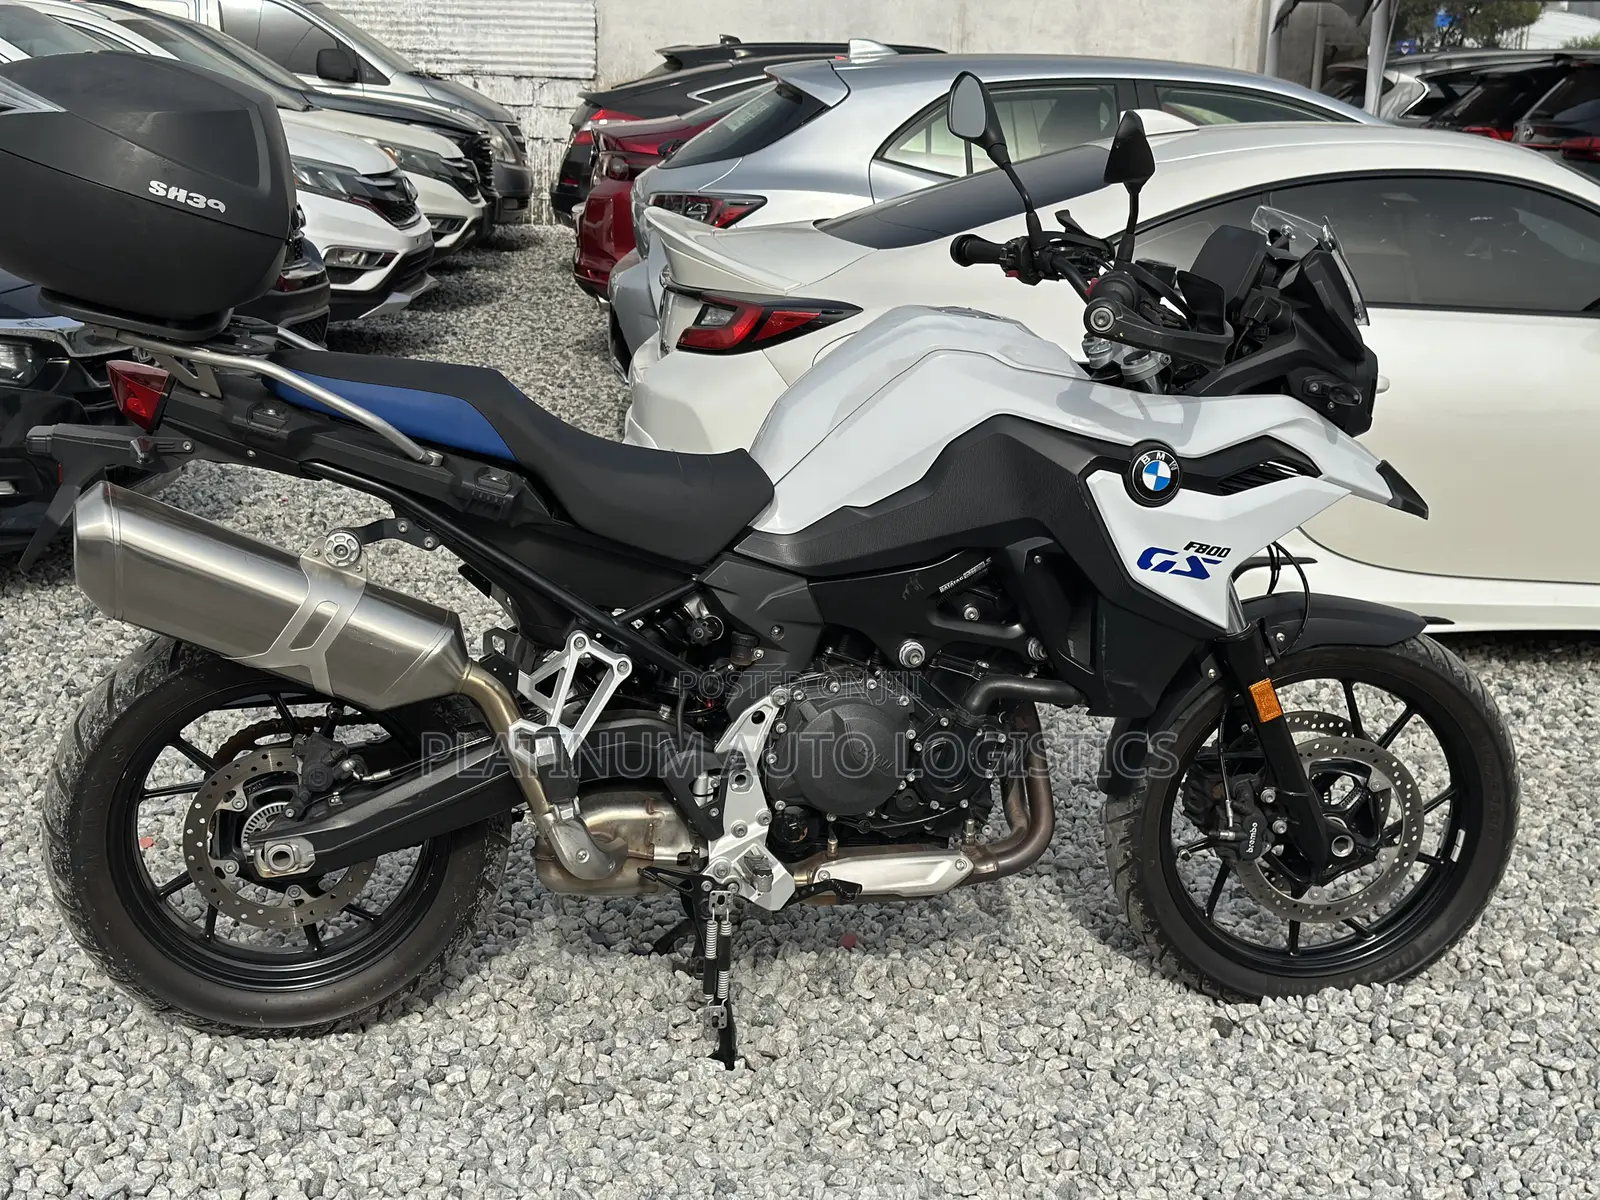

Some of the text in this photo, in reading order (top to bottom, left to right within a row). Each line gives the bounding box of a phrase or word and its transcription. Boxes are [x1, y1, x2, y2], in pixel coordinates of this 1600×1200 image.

[148, 180, 226, 213] SH39
[1140, 452, 1178, 471] BMW
[1137, 547, 1222, 580] GS
[1183, 541, 1231, 558] F800
[1246, 822, 1258, 853] brembo
